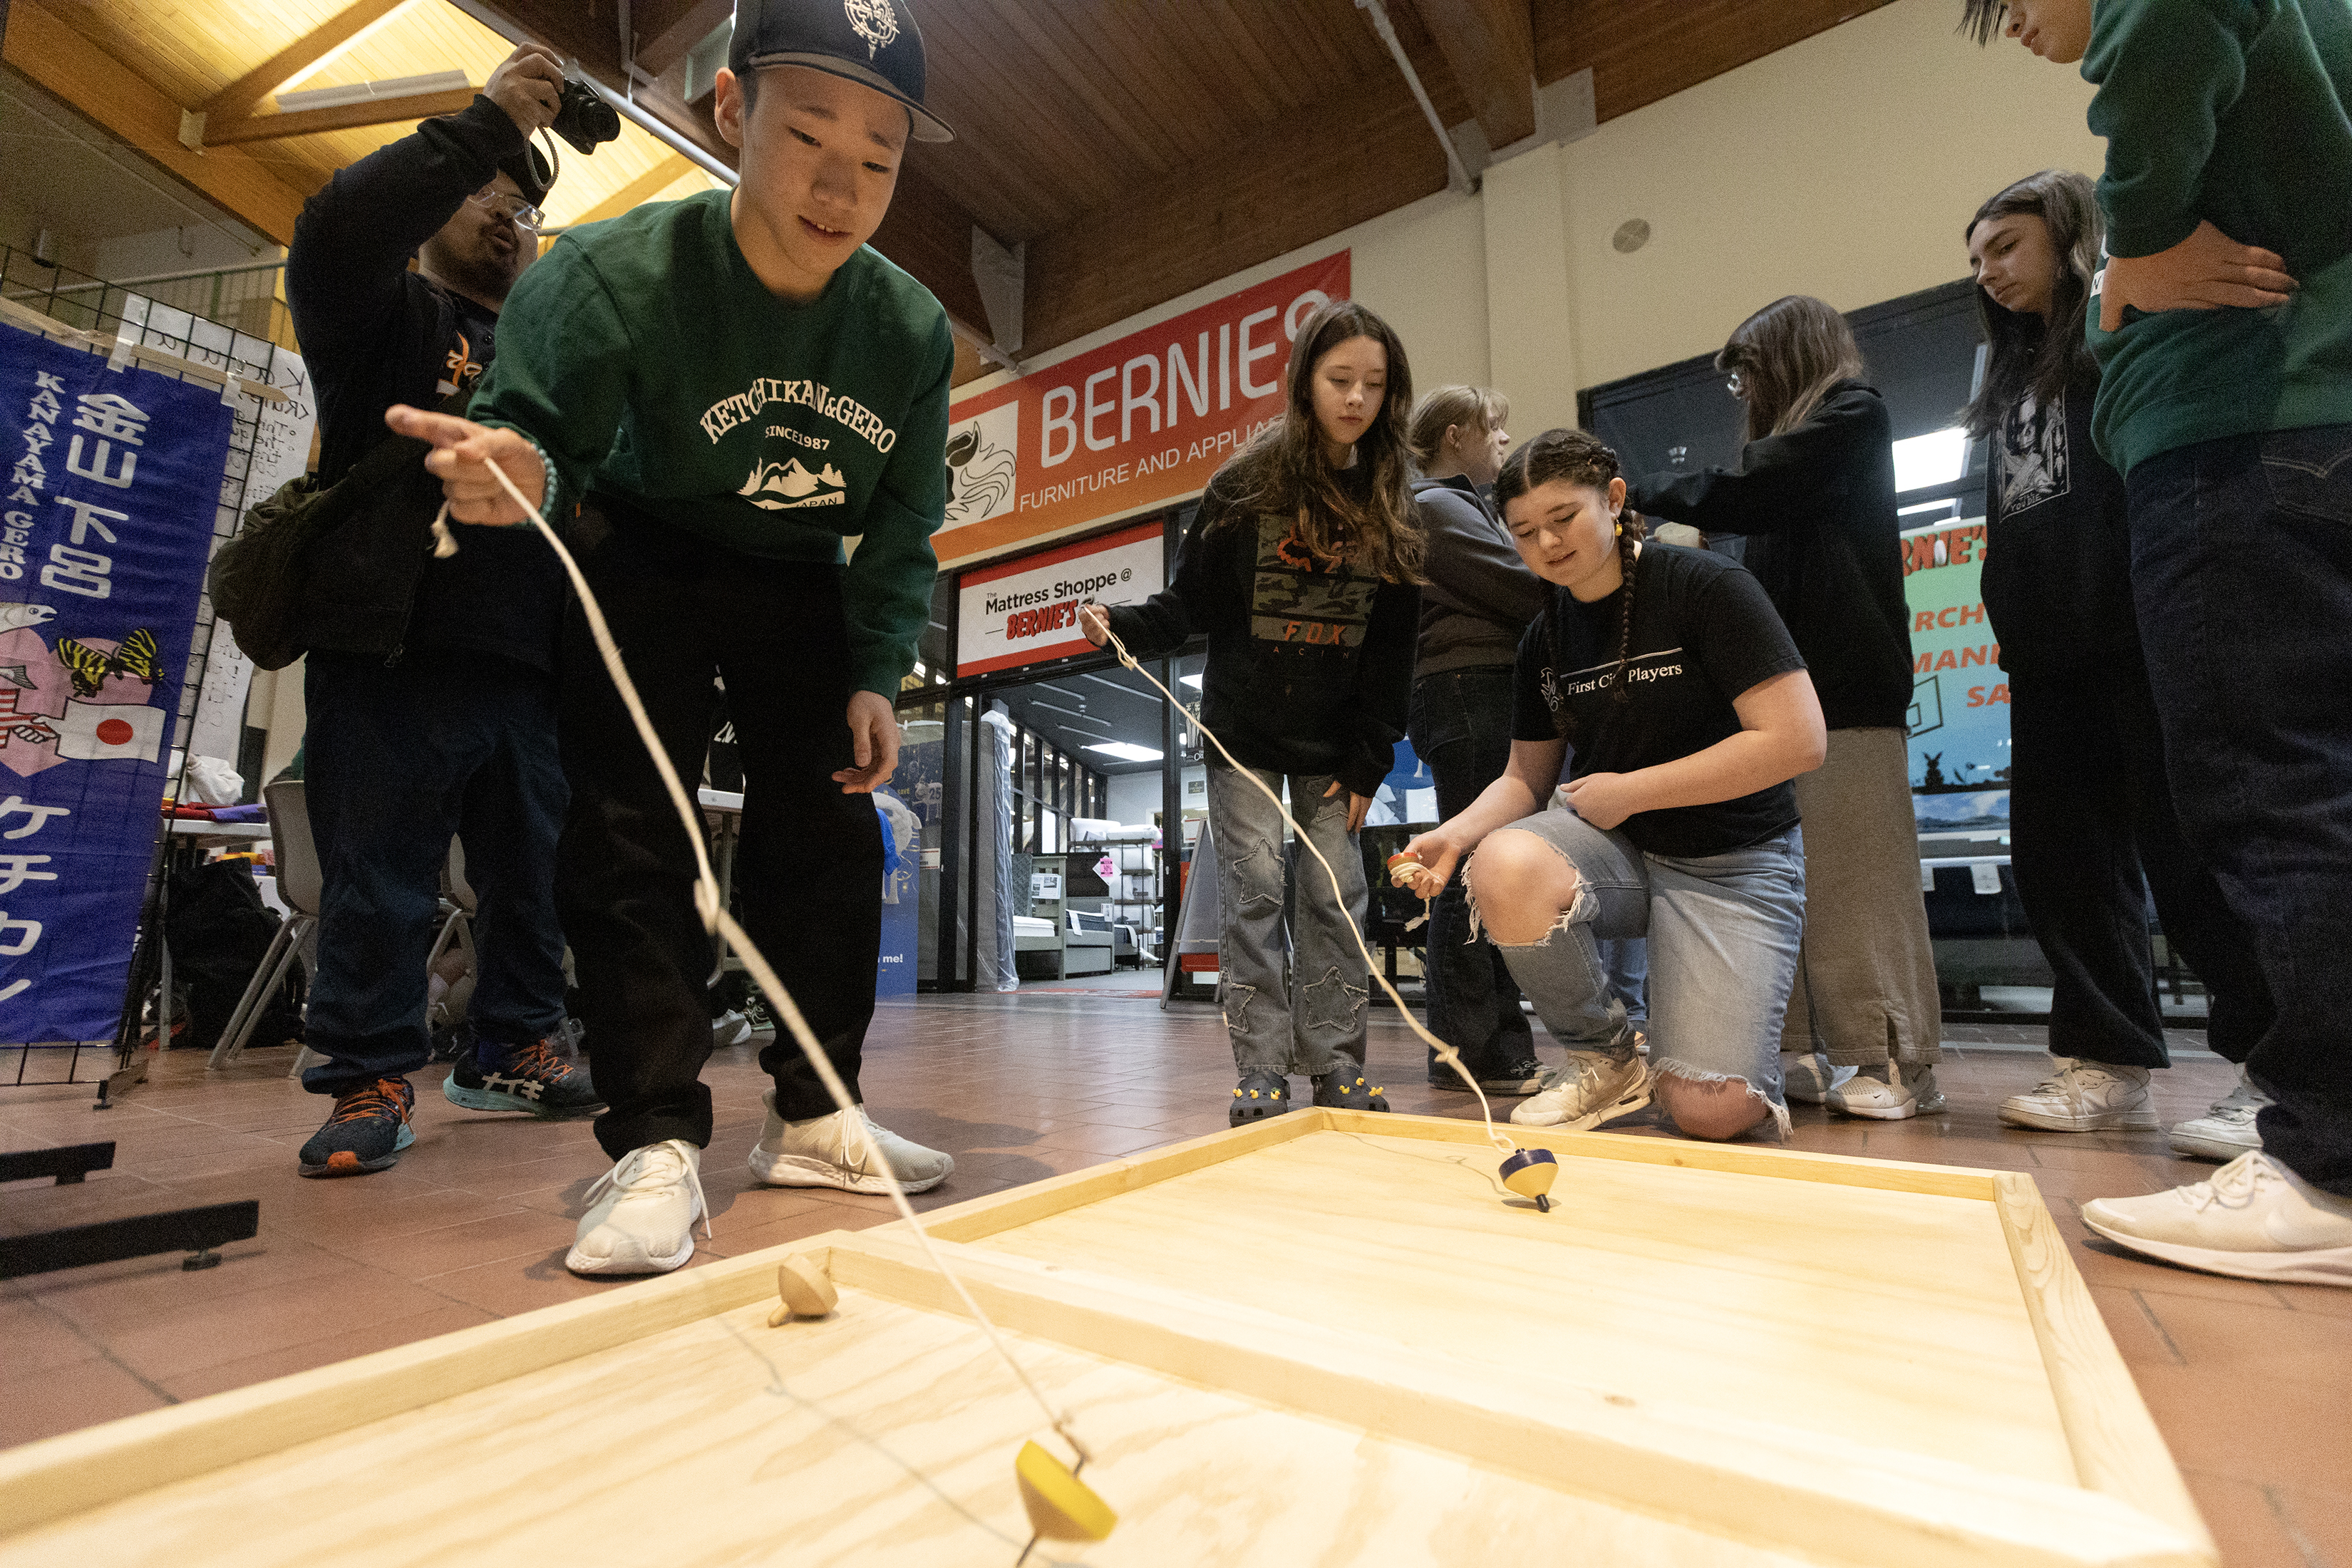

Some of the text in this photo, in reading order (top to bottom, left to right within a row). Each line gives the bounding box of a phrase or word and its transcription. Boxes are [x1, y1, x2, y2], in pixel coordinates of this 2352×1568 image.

[0, 371, 66, 579] KANAYAMA GERO
[1019, 421, 1267, 512] FURNITURE AND APPLIA
[40, 393, 150, 599] 金山下呂
[1901, 525, 1988, 577] RNIE'
[985, 568, 1132, 614] Mattress Shoppe @
[1006, 599, 1079, 640] BERNIE'S
[1284, 621, 1346, 645] FOX
[1912, 602, 1986, 633] RCH
[1273, 646, 1349, 659] ACIN
[1567, 680, 1596, 696] First
[1628, 664, 1683, 683] Players
[1967, 684, 2011, 708] SA
[882, 954, 903, 964] me!
